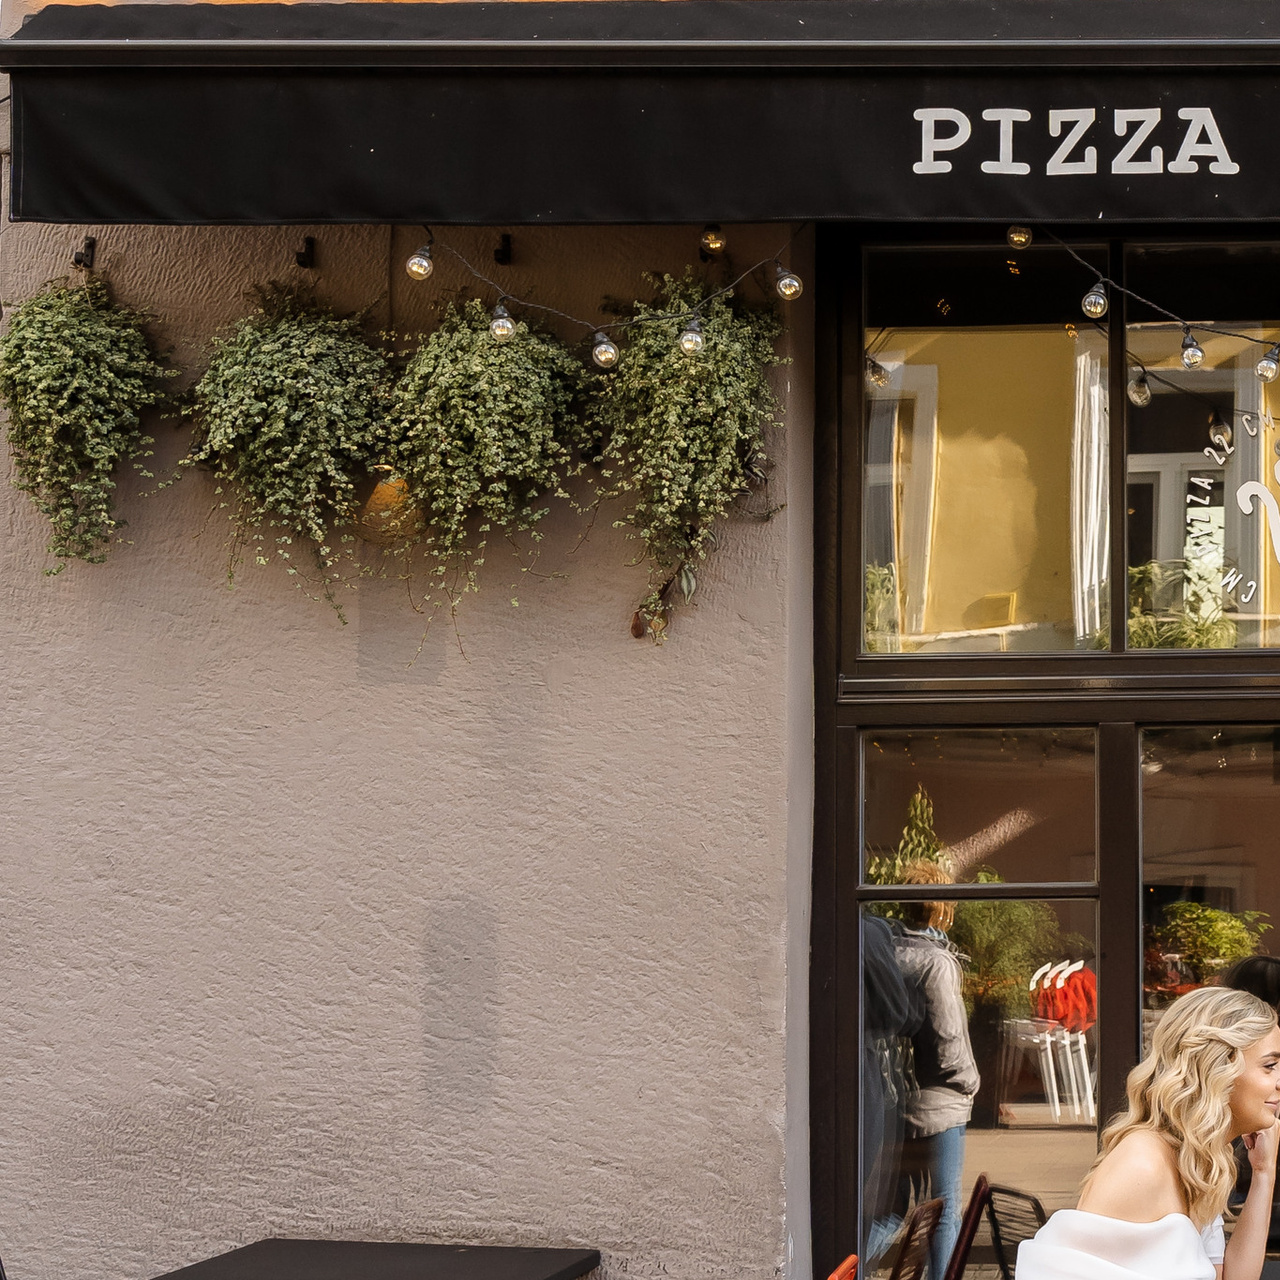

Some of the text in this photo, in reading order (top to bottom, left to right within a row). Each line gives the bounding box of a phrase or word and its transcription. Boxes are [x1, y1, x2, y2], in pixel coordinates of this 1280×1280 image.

[912, 106, 1241, 176] PIZZA
[1186, 408, 1275, 557] PIZZA 22 CM
[1220, 567, 1257, 603] CM
